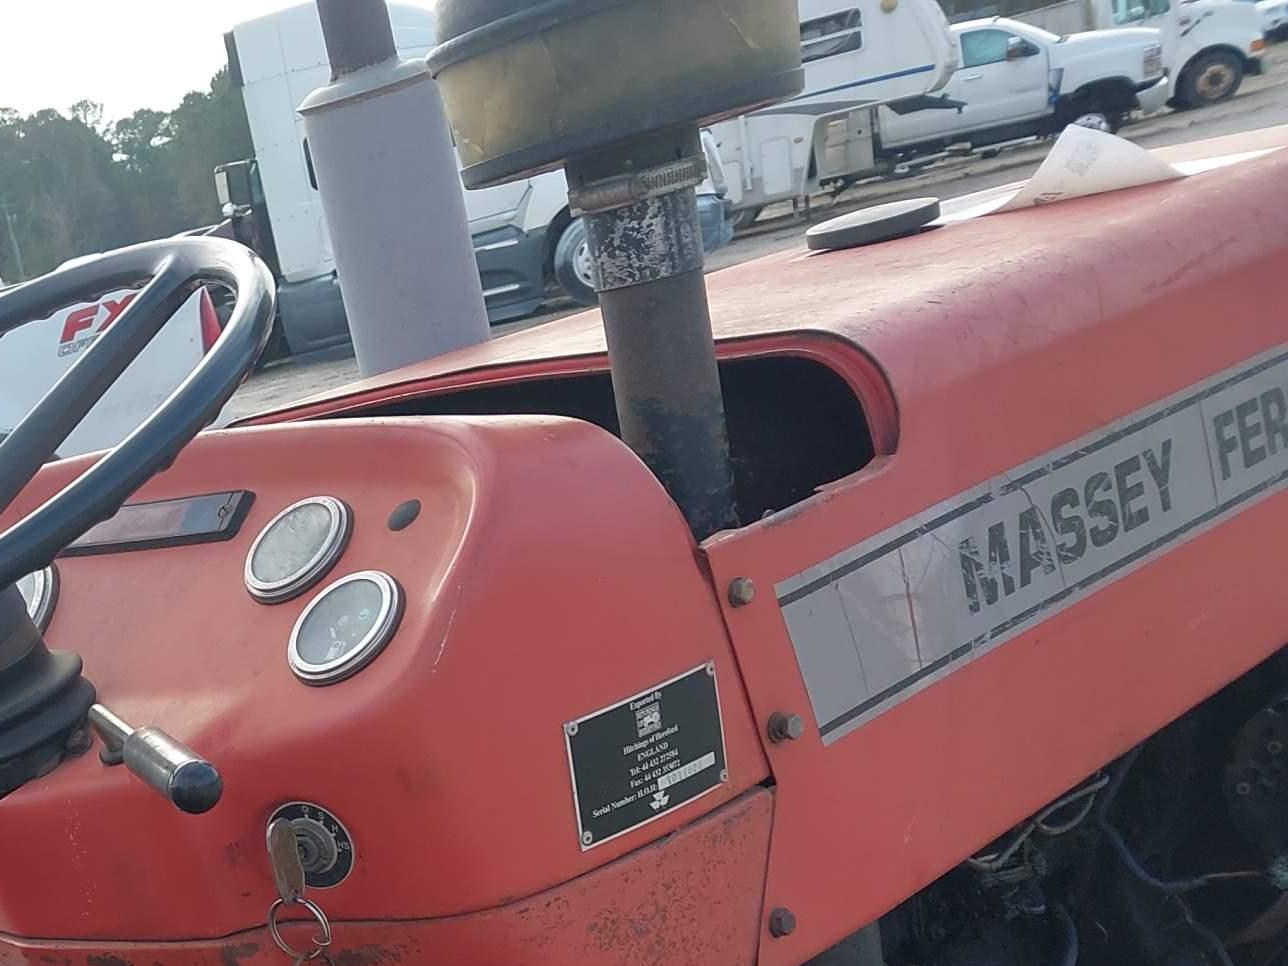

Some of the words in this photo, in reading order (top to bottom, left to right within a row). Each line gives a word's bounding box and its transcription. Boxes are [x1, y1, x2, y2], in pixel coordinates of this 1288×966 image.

[958, 439, 1172, 615] MASSEY
[630, 694, 654, 711] Exported
[648, 734, 655, 743] of
[655, 724, 678, 740] Hereford
[637, 741, 668, 761] ENGLAND
[630, 776, 643, 788] Fax:
[592, 803, 610, 818] Serial
[611, 794, 637, 810] Number:
